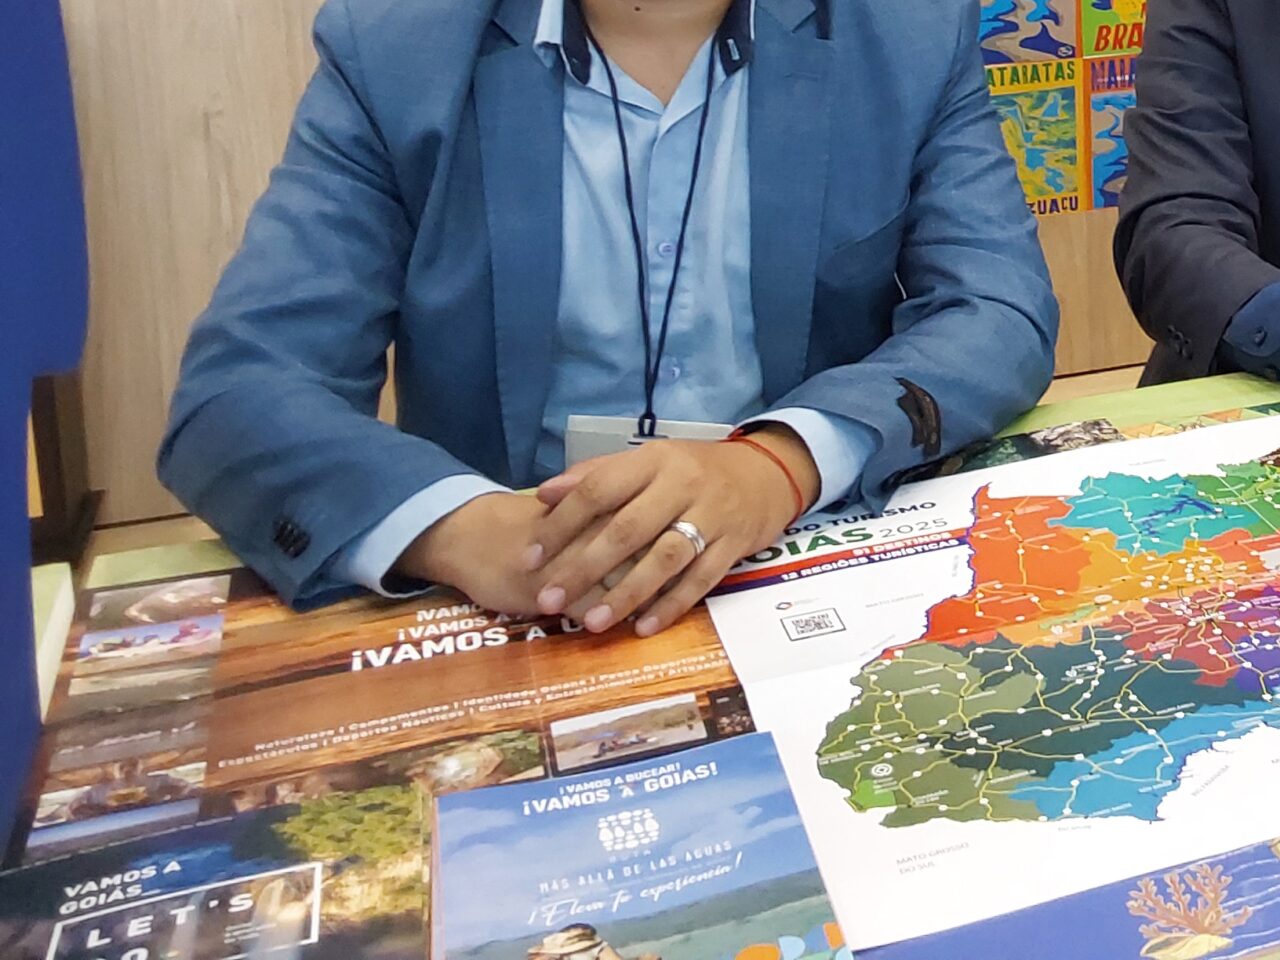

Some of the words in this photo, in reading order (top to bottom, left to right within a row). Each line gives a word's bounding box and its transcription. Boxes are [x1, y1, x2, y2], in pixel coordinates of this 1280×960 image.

[1094, 22, 1145, 53] BRA
[986, 61, 1075, 88] ATARATAS
[732, 527, 874, 569] OIÁS
[879, 518, 948, 538] 2025
[874, 531, 953, 553] DESTINOS
[526, 626, 546, 640] A
[64, 865, 157, 898] VAMOS
[163, 860, 182, 874] A
